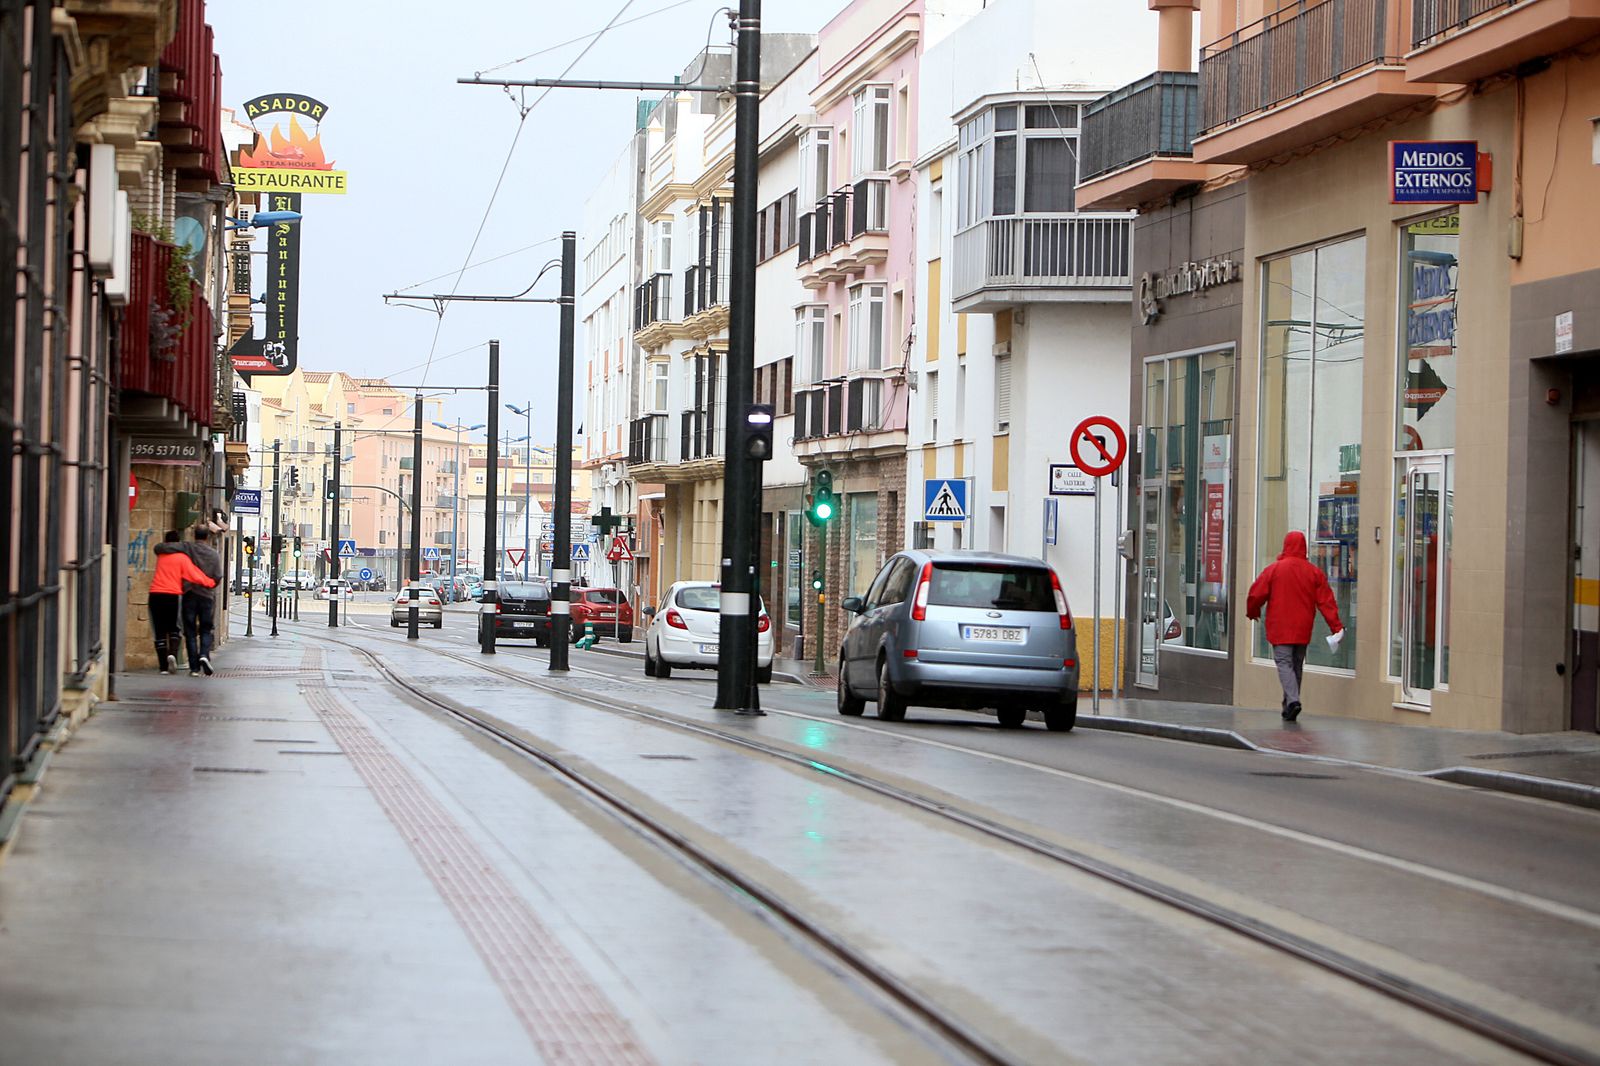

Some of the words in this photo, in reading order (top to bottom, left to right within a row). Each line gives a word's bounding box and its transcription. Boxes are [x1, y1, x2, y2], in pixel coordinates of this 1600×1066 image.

[248, 98, 323, 117] ASADOR
[1402, 150, 1464, 167] MEDIOS
[1395, 171, 1472, 187] EXTERNOS
[156, 445, 168, 455] 53
[169, 445, 180, 455] 71
[182, 446, 195, 455] 60
[973, 628, 998, 639] 5783
[1002, 630, 1020, 640] DBZ
